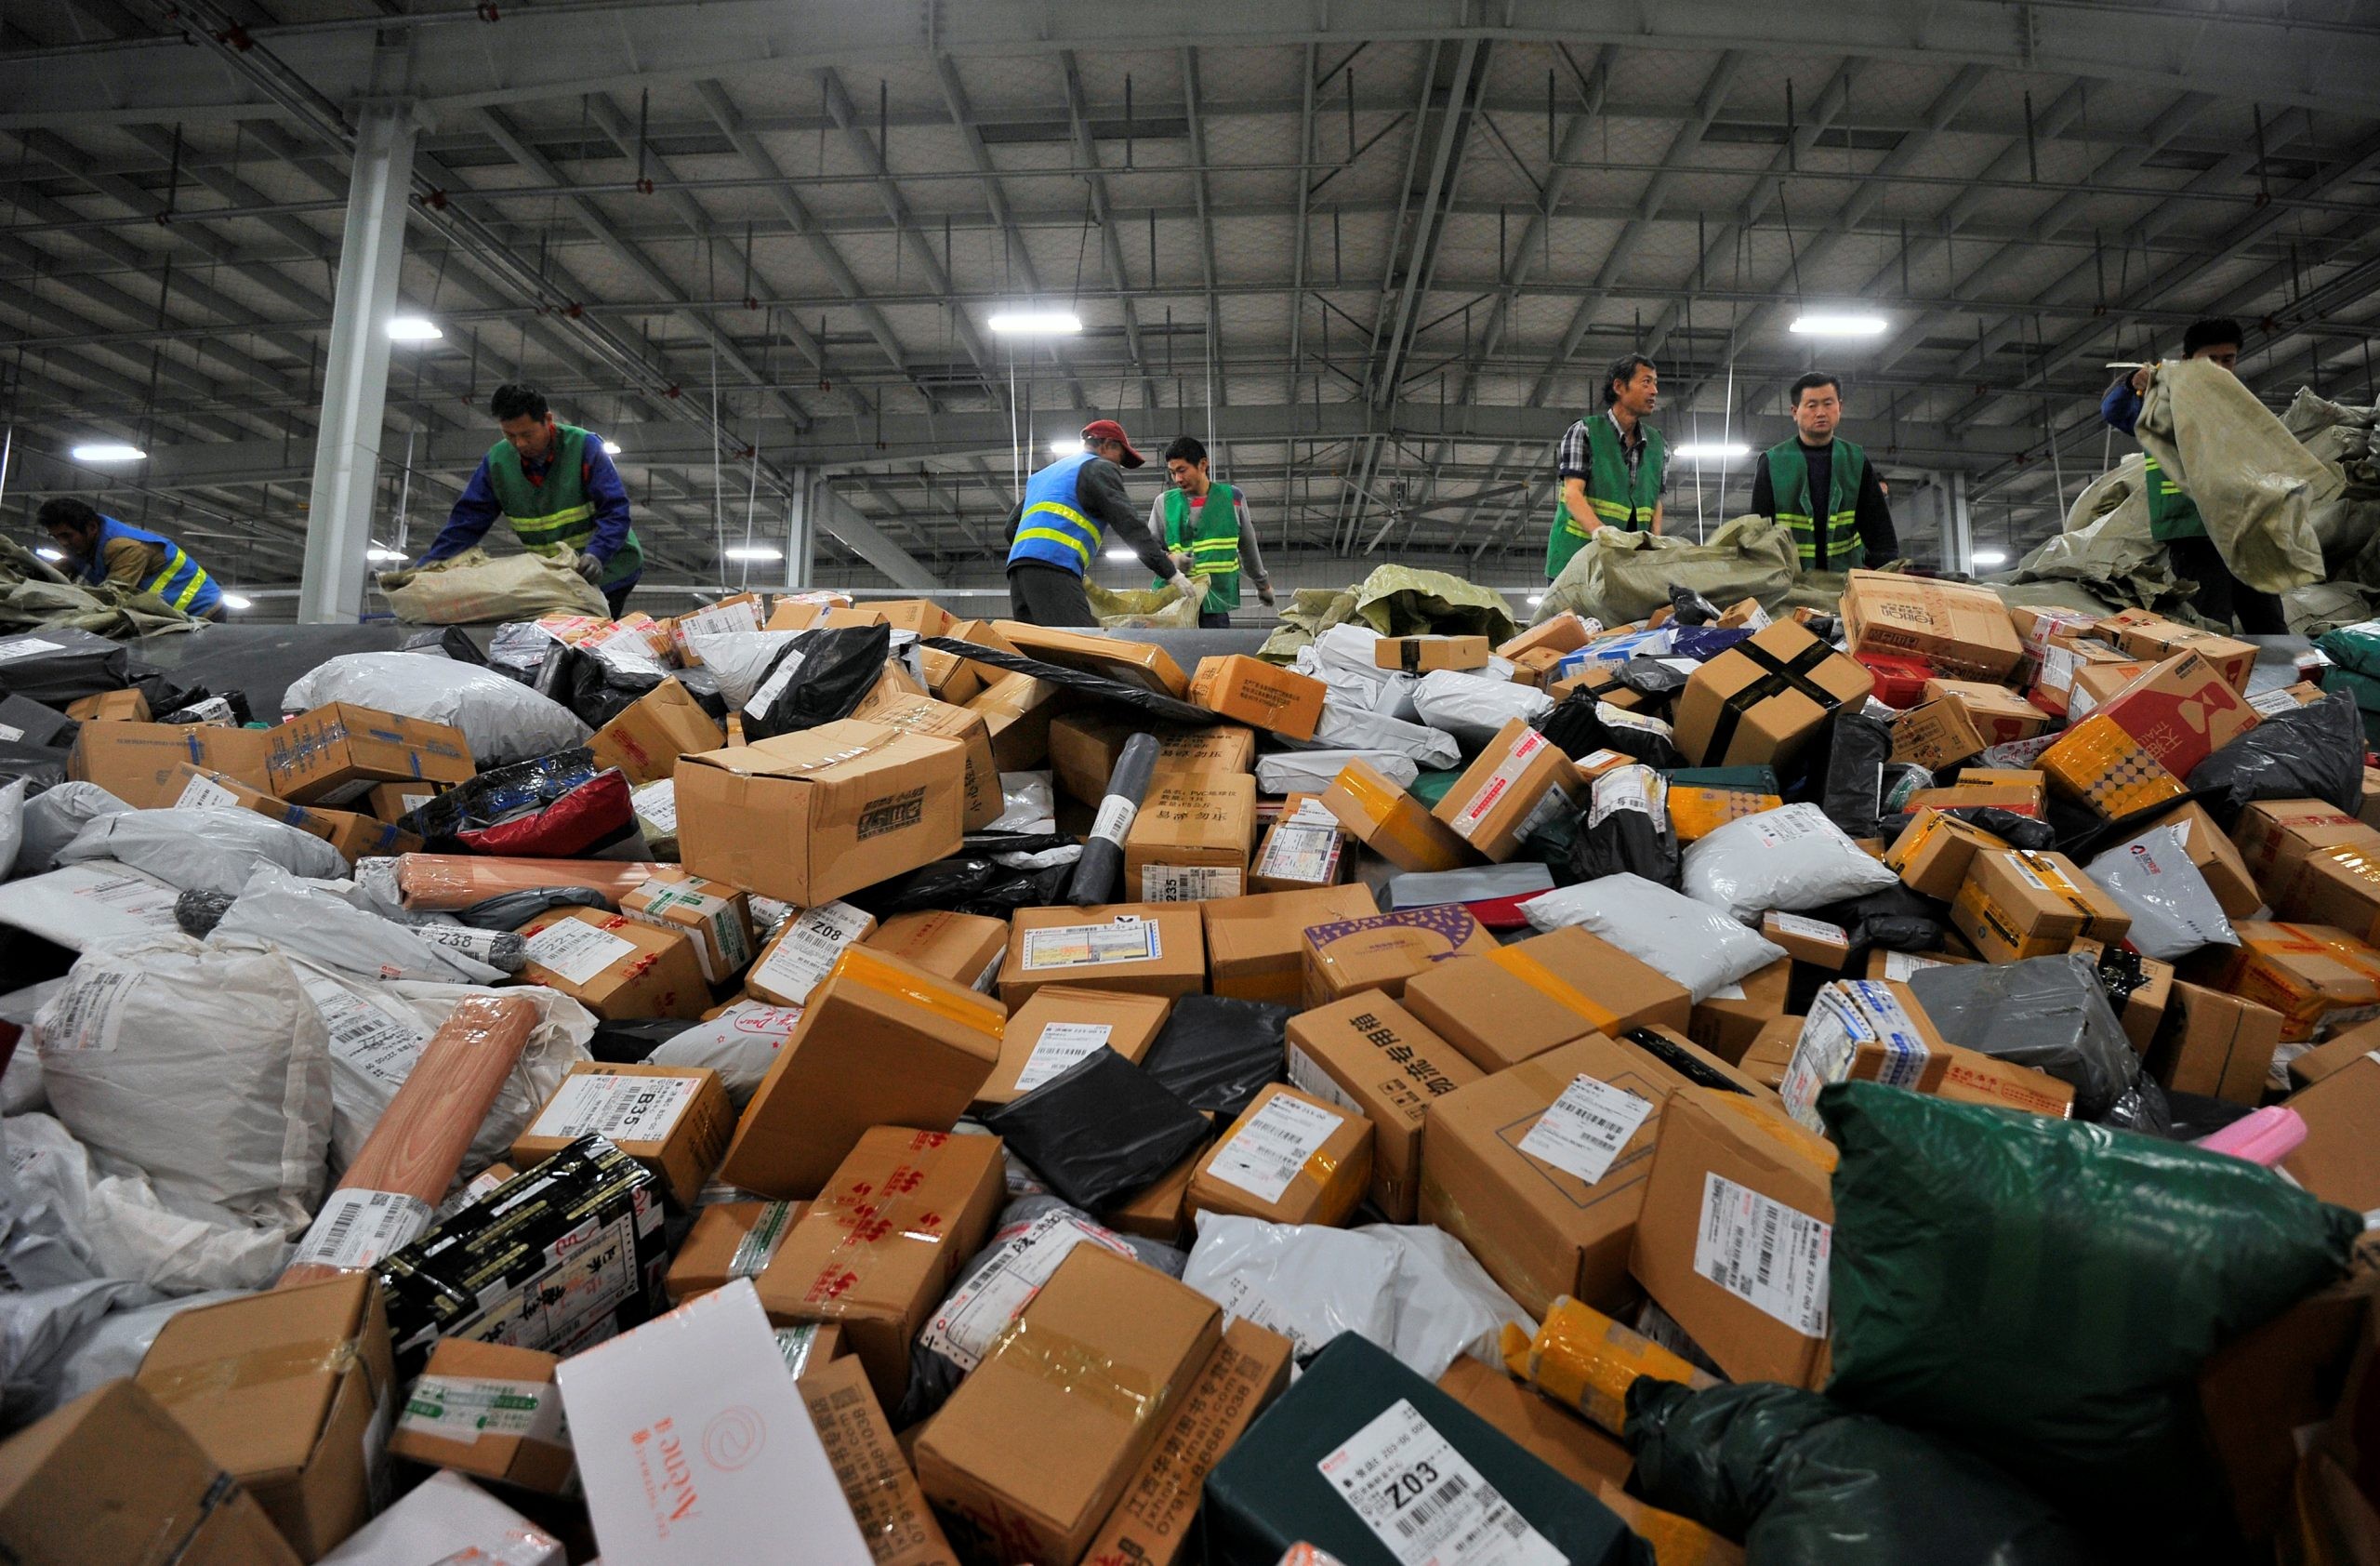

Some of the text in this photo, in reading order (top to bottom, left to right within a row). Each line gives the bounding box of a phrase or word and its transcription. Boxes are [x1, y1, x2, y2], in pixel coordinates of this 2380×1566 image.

[2137, 721, 2169, 744] TMALL
[2145, 728, 2184, 760] 天猫
[1165, 879, 1177, 902] 235
[438, 932, 472, 948] 238
[811, 921, 842, 941] Z08
[1349, 1013, 1459, 1098] 物流专用箱
[624, 1093, 655, 1125] B35
[1384, 1461, 1438, 1510] Z03
